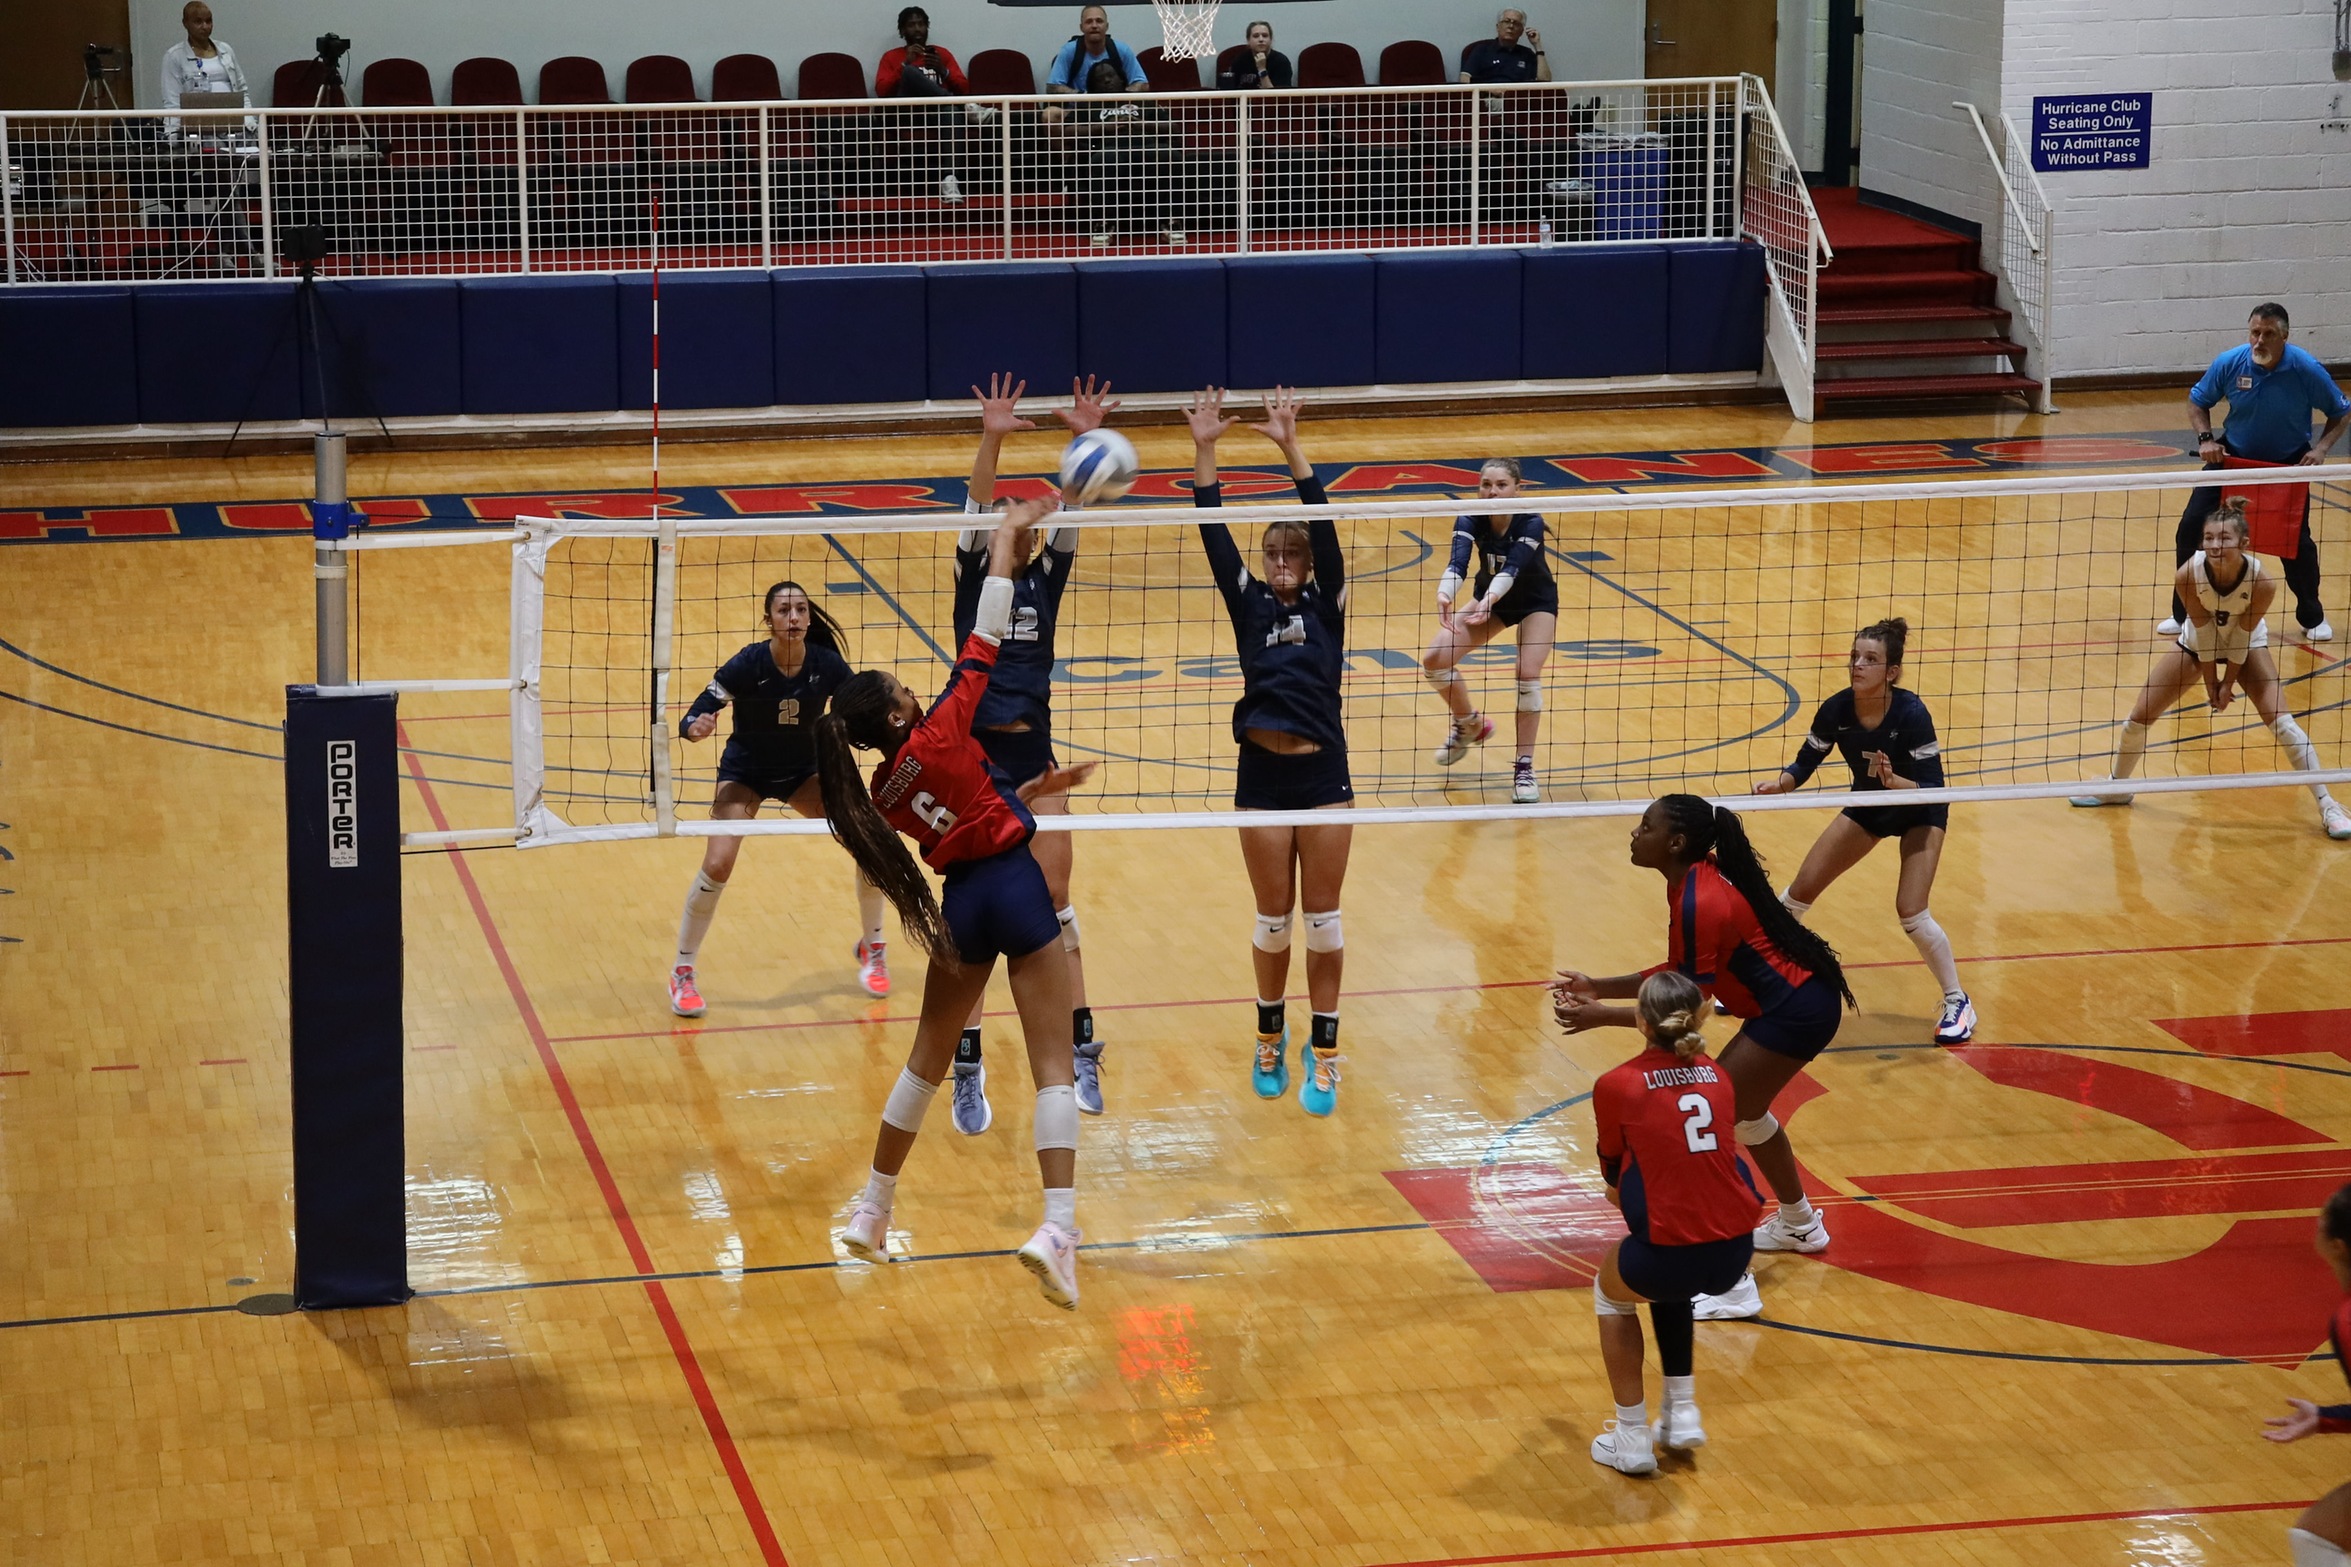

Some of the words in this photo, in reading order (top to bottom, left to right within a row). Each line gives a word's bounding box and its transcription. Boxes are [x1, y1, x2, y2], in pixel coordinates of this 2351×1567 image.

[2042, 101, 2107, 115] Hurricane
[2111, 99, 2141, 112] Club
[2048, 116, 2100, 130] Seating
[2103, 115, 2134, 129] Only
[2040, 139, 2059, 151] No
[2063, 137, 2141, 150] Admittance
[2047, 152, 2100, 165] Without
[2103, 151, 2137, 163] Pass
[778, 698, 800, 726] 2
[911, 791, 958, 836] 6
[1643, 1065, 1719, 1091] LOUISBURG
[1677, 1092, 1718, 1154] 2
